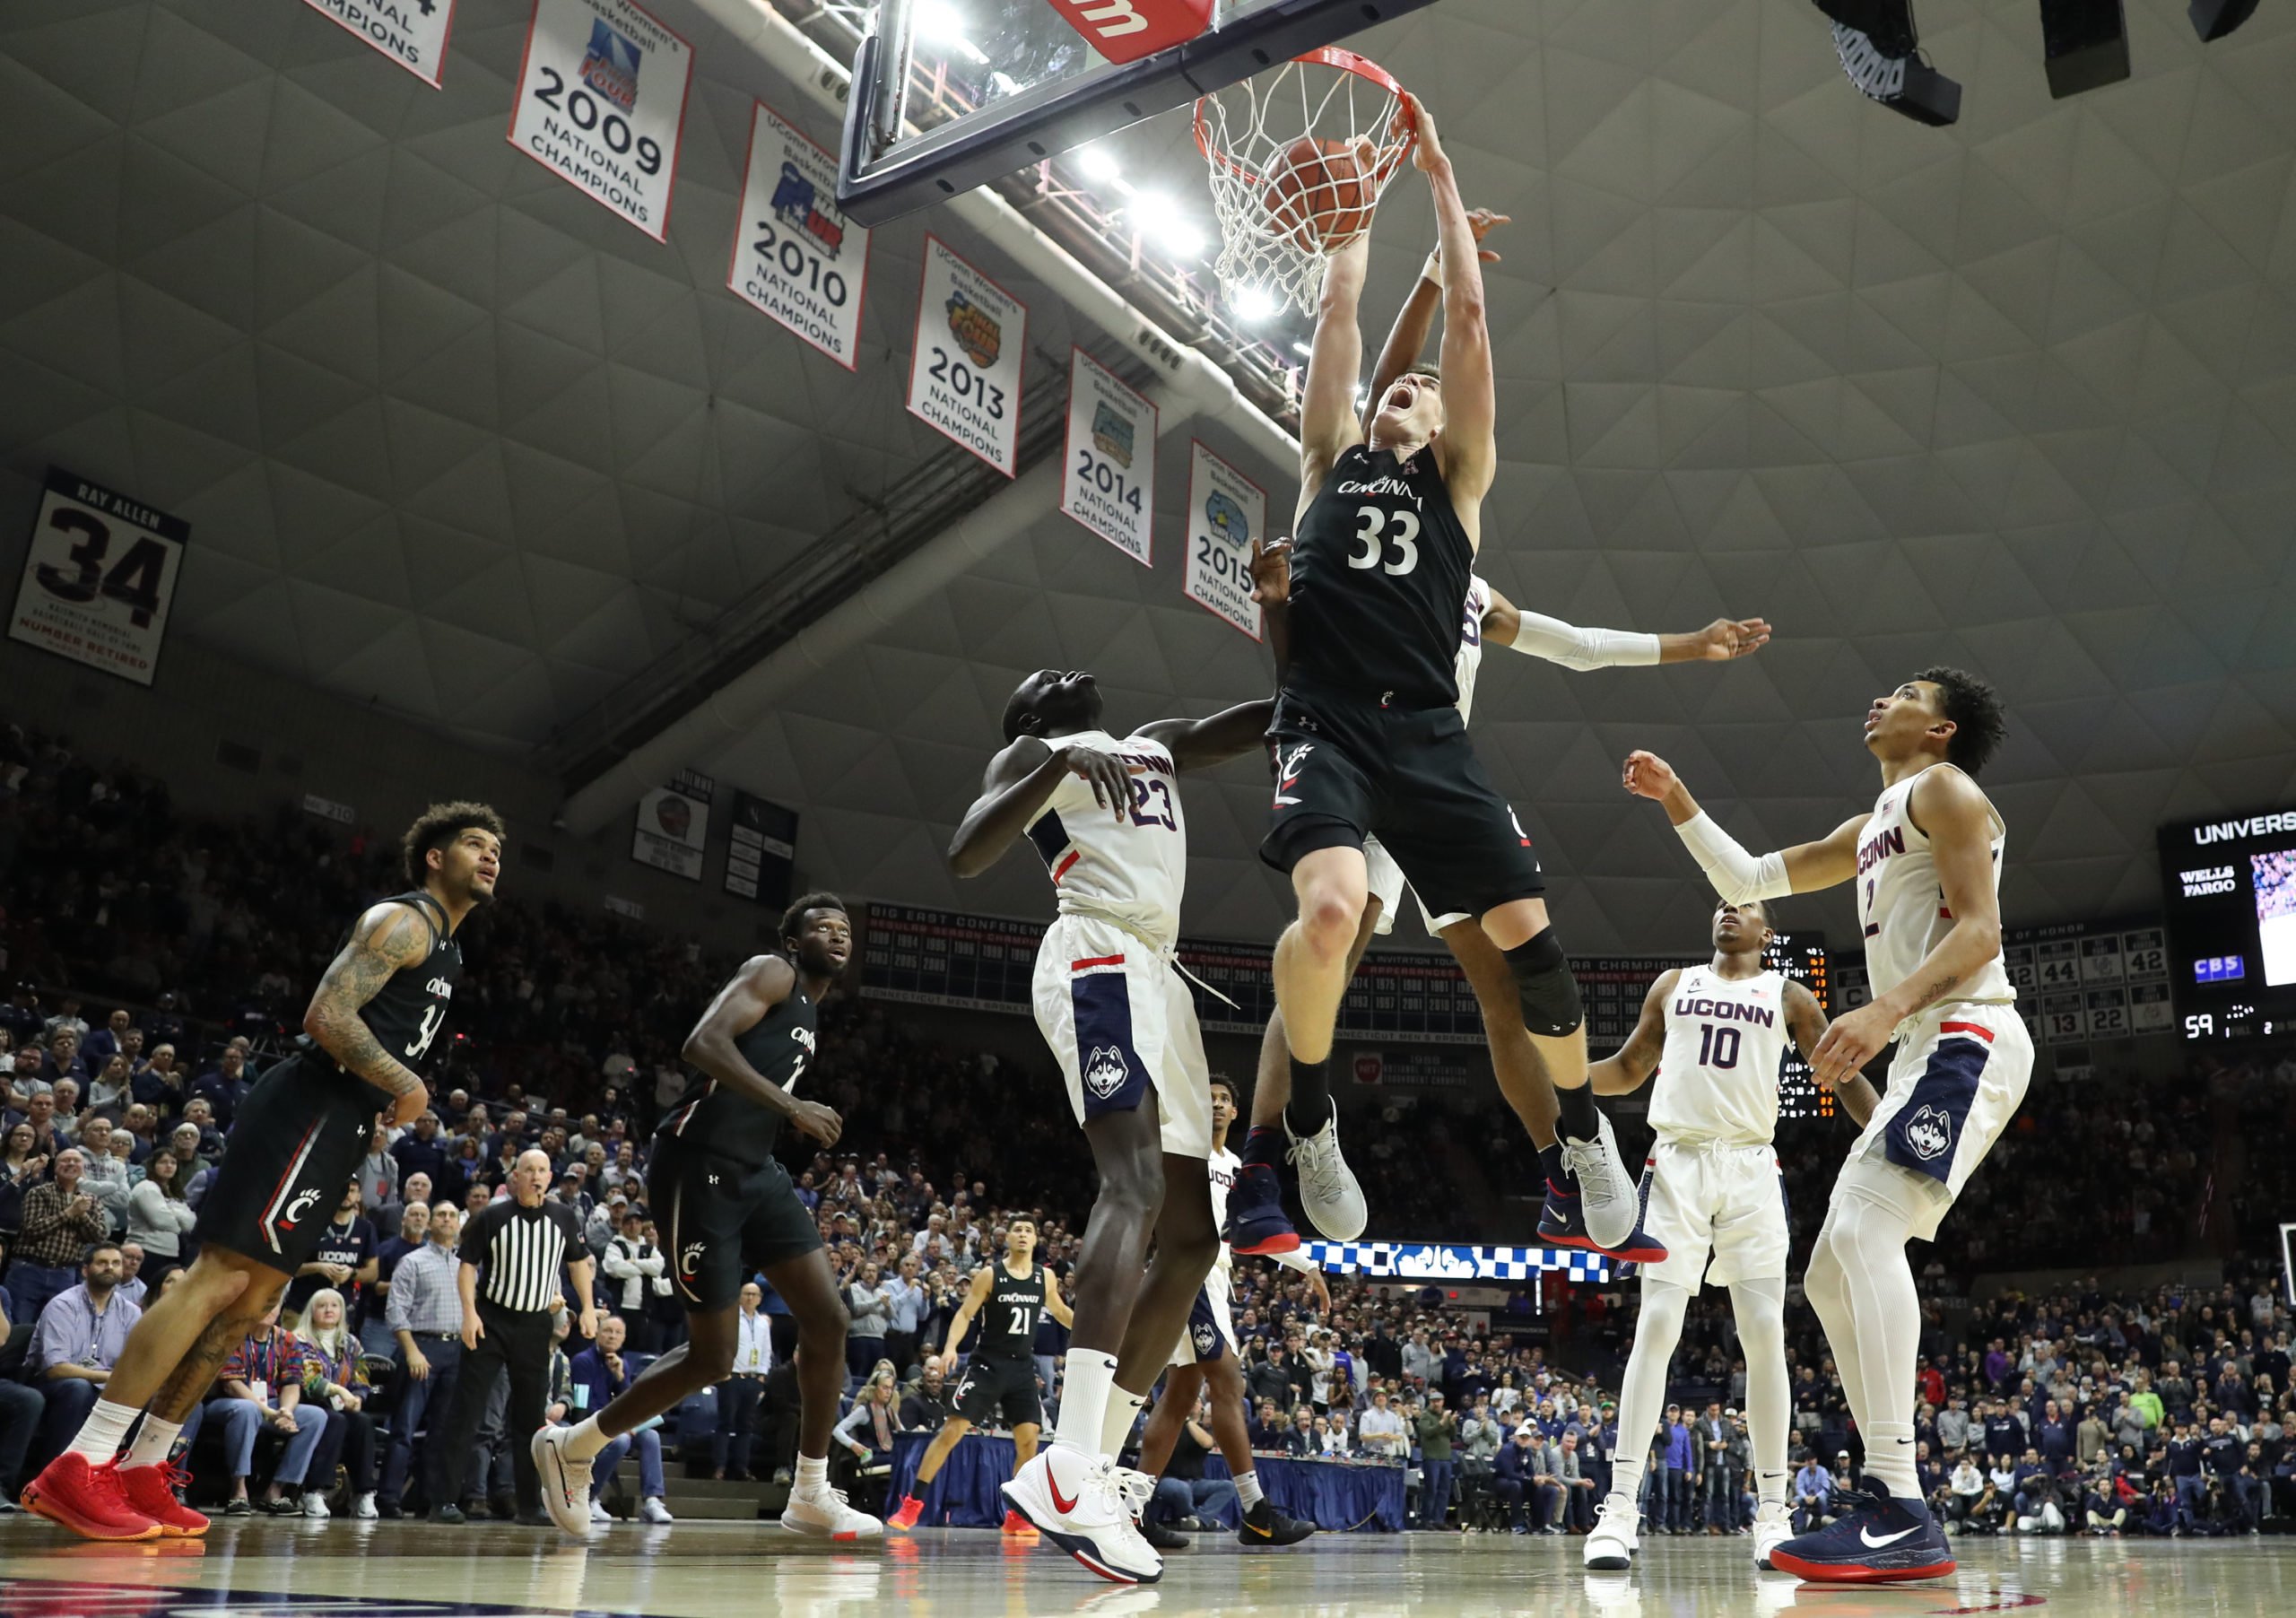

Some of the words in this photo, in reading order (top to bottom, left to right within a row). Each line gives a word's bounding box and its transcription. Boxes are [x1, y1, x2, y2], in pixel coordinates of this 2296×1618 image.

[323, 0, 420, 63] MPIONS
[534, 66, 662, 177] 2009
[766, 114, 809, 152] UConn
[544, 117, 644, 196] NATIONAL
[783, 144, 838, 192] Basketba
[530, 135, 648, 222] CHAMPIONS
[752, 221, 848, 308] 2010
[935, 245, 970, 279] UConn
[756, 264, 839, 330] NATIONAL
[949, 272, 1003, 318] Basketball
[745, 280, 842, 354] CHAMPIONS
[928, 346, 1004, 421] 2013
[1080, 355, 1112, 387] UConn
[929, 384, 998, 440] NATIONAL
[1092, 379, 1138, 419] Basketball
[922, 400, 1003, 463] CHAMPIONS
[1077, 449, 1142, 515] 2014
[76, 483, 110, 507] RAY
[112, 499, 161, 530] ALLEN
[1079, 485, 1137, 534] NATIONAL
[1073, 500, 1142, 554] CHAMPIONS
[1348, 506, 1421, 576] 33
[35, 507, 169, 631] 34
[1196, 535, 1252, 594] 2015
[1193, 583, 1254, 631] CHAMPIONS
[1198, 569, 1250, 612] NATIONAL
[19, 616, 83, 647] NUMBER
[86, 640, 148, 670] RETIRED
[1128, 778, 1177, 832] 23
[2194, 811, 2296, 845] UNIVERS
[1857, 825, 1906, 875] CONN
[2179, 865, 2236, 883] WELLS
[2183, 878, 2237, 898] FARGO
[870, 905, 898, 919] BIG
[906, 909, 947, 925] EAST
[956, 917, 1047, 936] CONFERENC
[1865, 878, 1880, 938] 2
[870, 918, 927, 933] REGULAR
[932, 925, 982, 940] SEASON
[2015, 929, 2031, 940] OF
[2038, 923, 2085, 937] HONOR
[897, 933, 918, 948] 1994
[1011, 947, 1031, 962] 1999
[1198, 954, 1269, 968] CHAMPIONS
[1377, 954, 1431, 965] INVITATION
[2132, 950, 2162, 970] 42
[1207, 966, 1230, 981] 2002
[1234, 970, 1257, 983] 2004
[1370, 966, 1456, 977] APPEARANCES
[1571, 961, 1591, 970] AA
[2045, 961, 2074, 981] 44
[2194, 956, 2239, 974] CBS
[865, 989, 941, 1003] CONNECTICUT
[1376, 978, 1396, 991] 1975
[1596, 983, 1618, 996] 1956
[1624, 983, 1644, 996] 1957
[1846, 987, 1863, 1006] C
[1376, 996, 1396, 1009] 1997
[1456, 999, 1477, 1013] 2015
[1674, 998, 1774, 1029] UCONN
[2093, 1009, 2123, 1030] 22
[404, 1004, 446, 1061] 34
[1212, 1022, 1265, 1033] BASKETBA
[1335, 1030, 1395, 1040] NNECTICUT
[2052, 1013, 2077, 1033] 13
[2185, 1013, 2213, 1040] 59
[1410, 1054, 1441, 1066] 1988
[1699, 1023, 1741, 1069] 10
[781, 1054, 806, 1095] 2
[1359, 1064, 1378, 1074] NIT
[1209, 1169, 1237, 1188] UCO
[317, 1250, 359, 1264] UCONN
[997, 1292, 1040, 1304] CINCINNATI
[1007, 1307, 1031, 1335] 21
